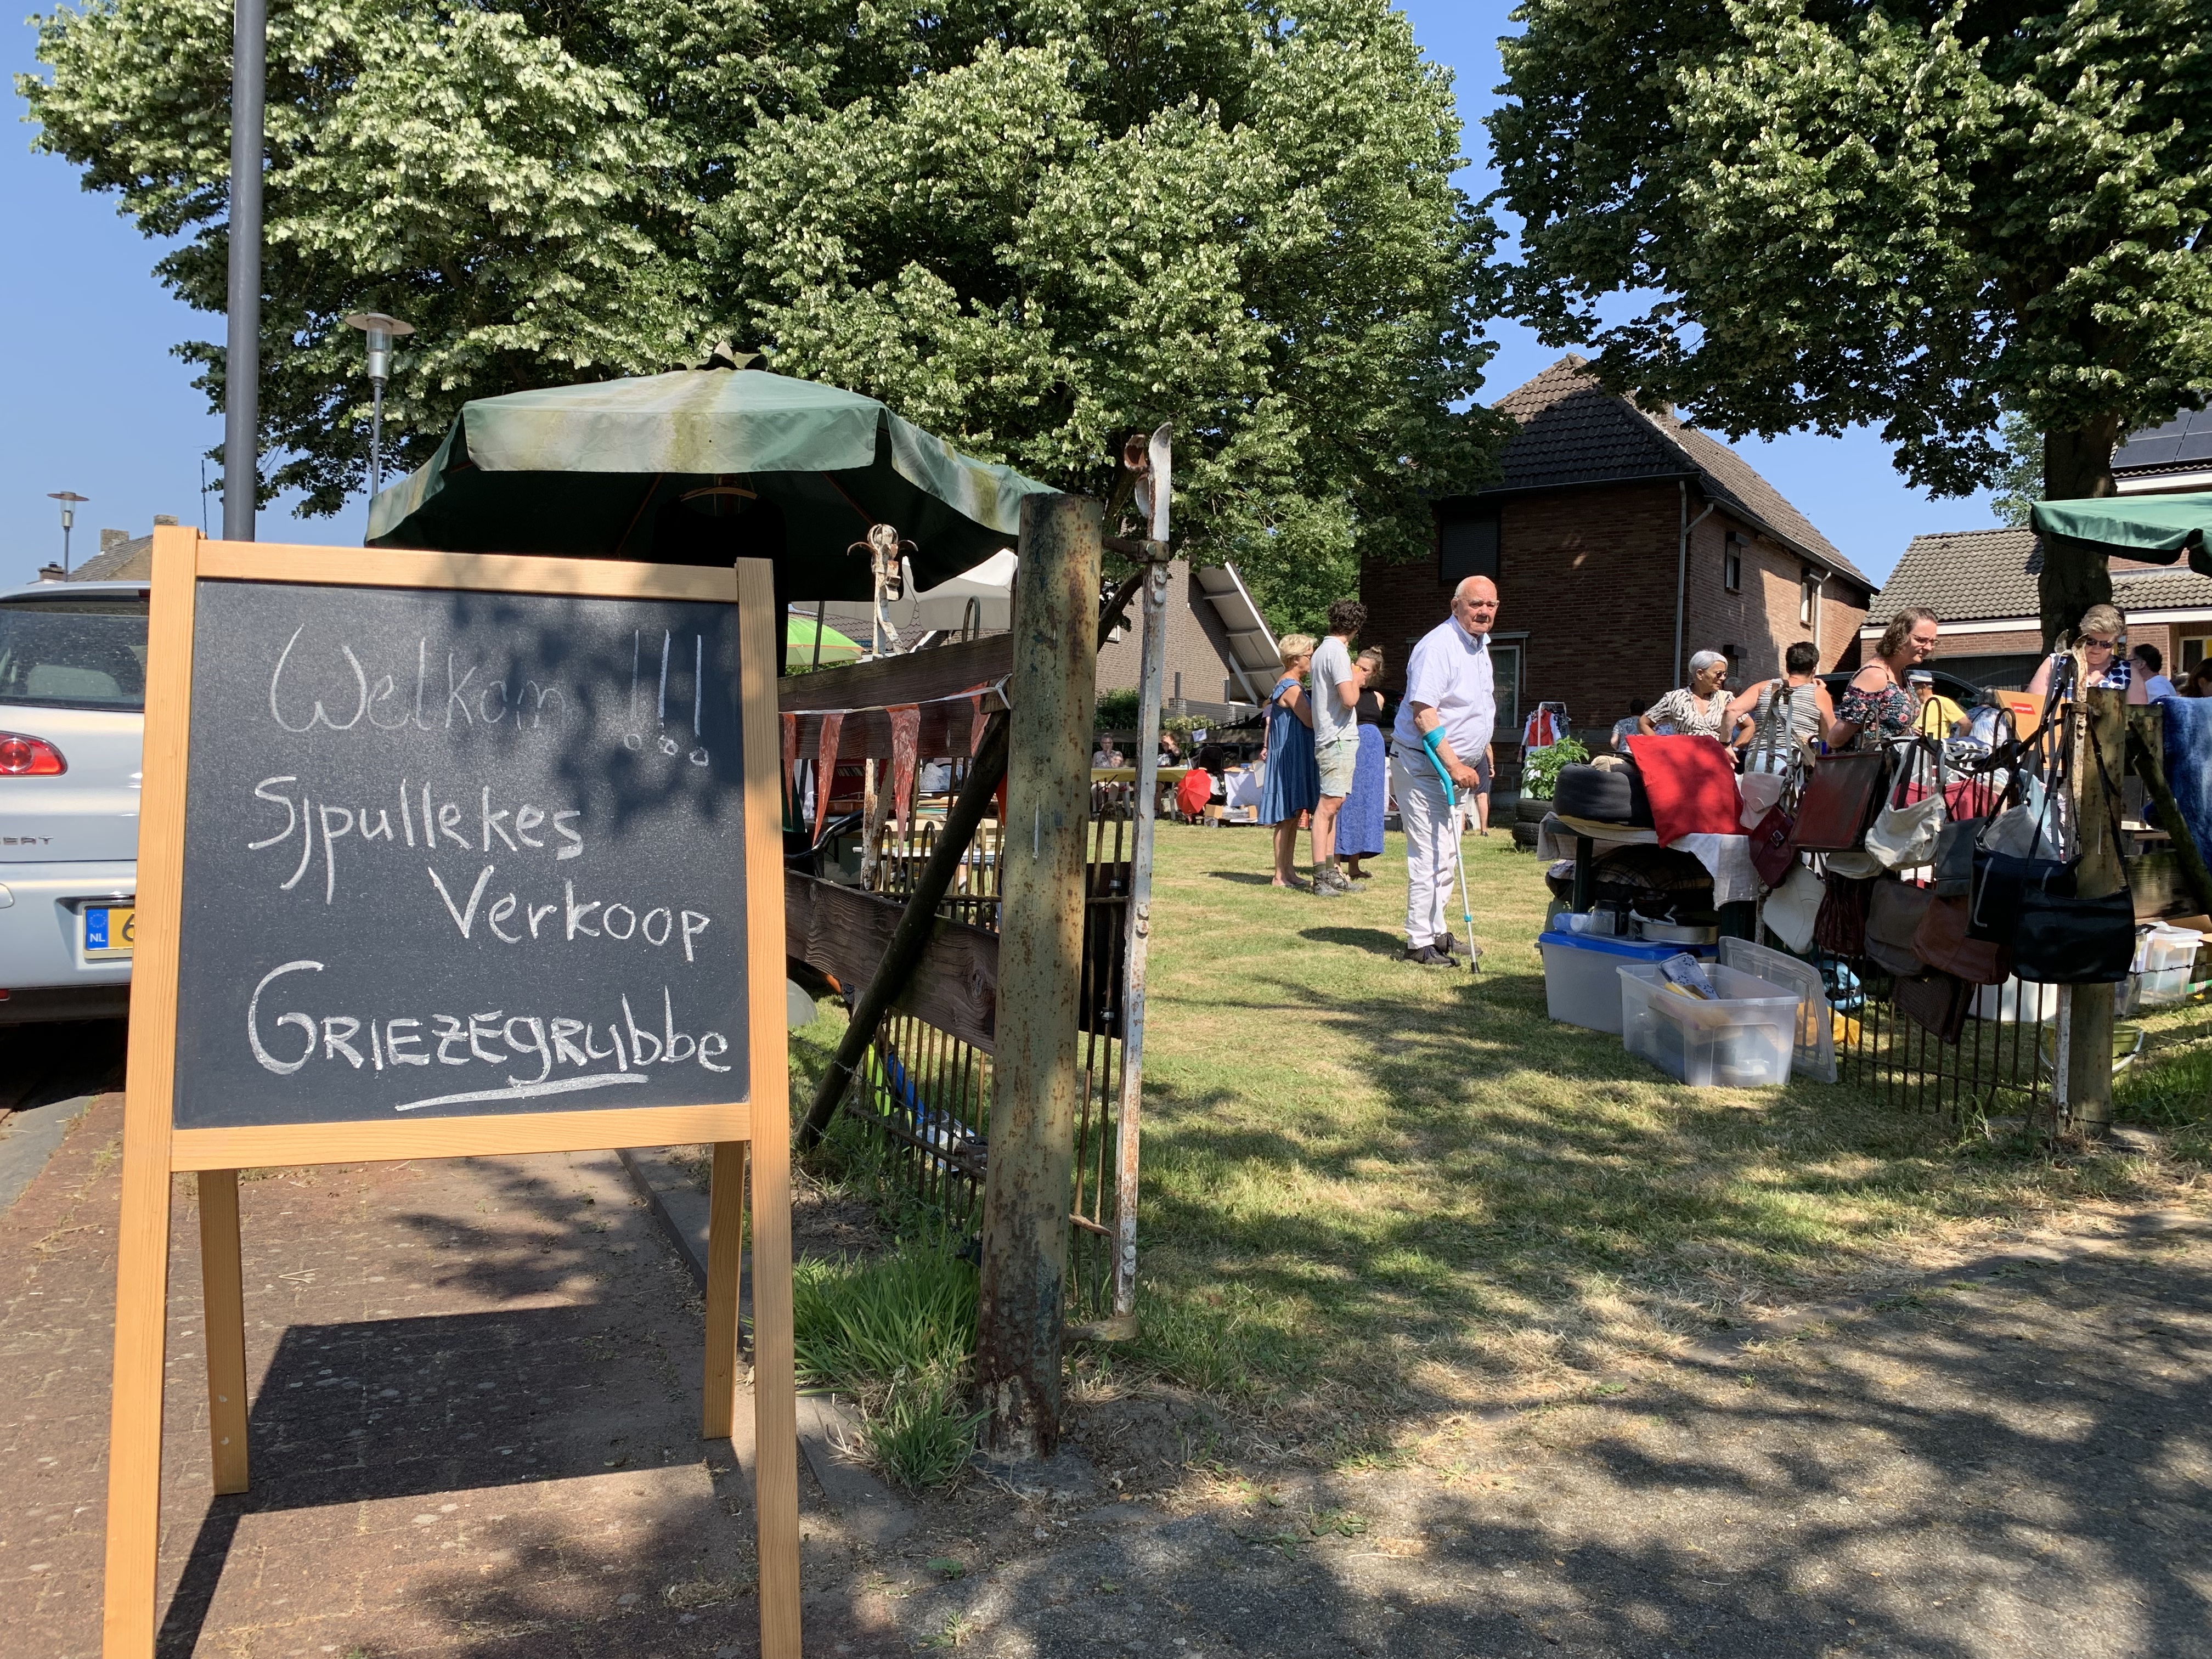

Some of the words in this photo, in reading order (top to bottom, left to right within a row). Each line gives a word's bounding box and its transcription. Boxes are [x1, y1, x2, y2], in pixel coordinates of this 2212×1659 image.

[270, 623, 566, 732] Welkom
[0, 835, 54, 845] EAT
[89, 933, 106, 943] NL
[428, 864, 711, 962] Verkoop
